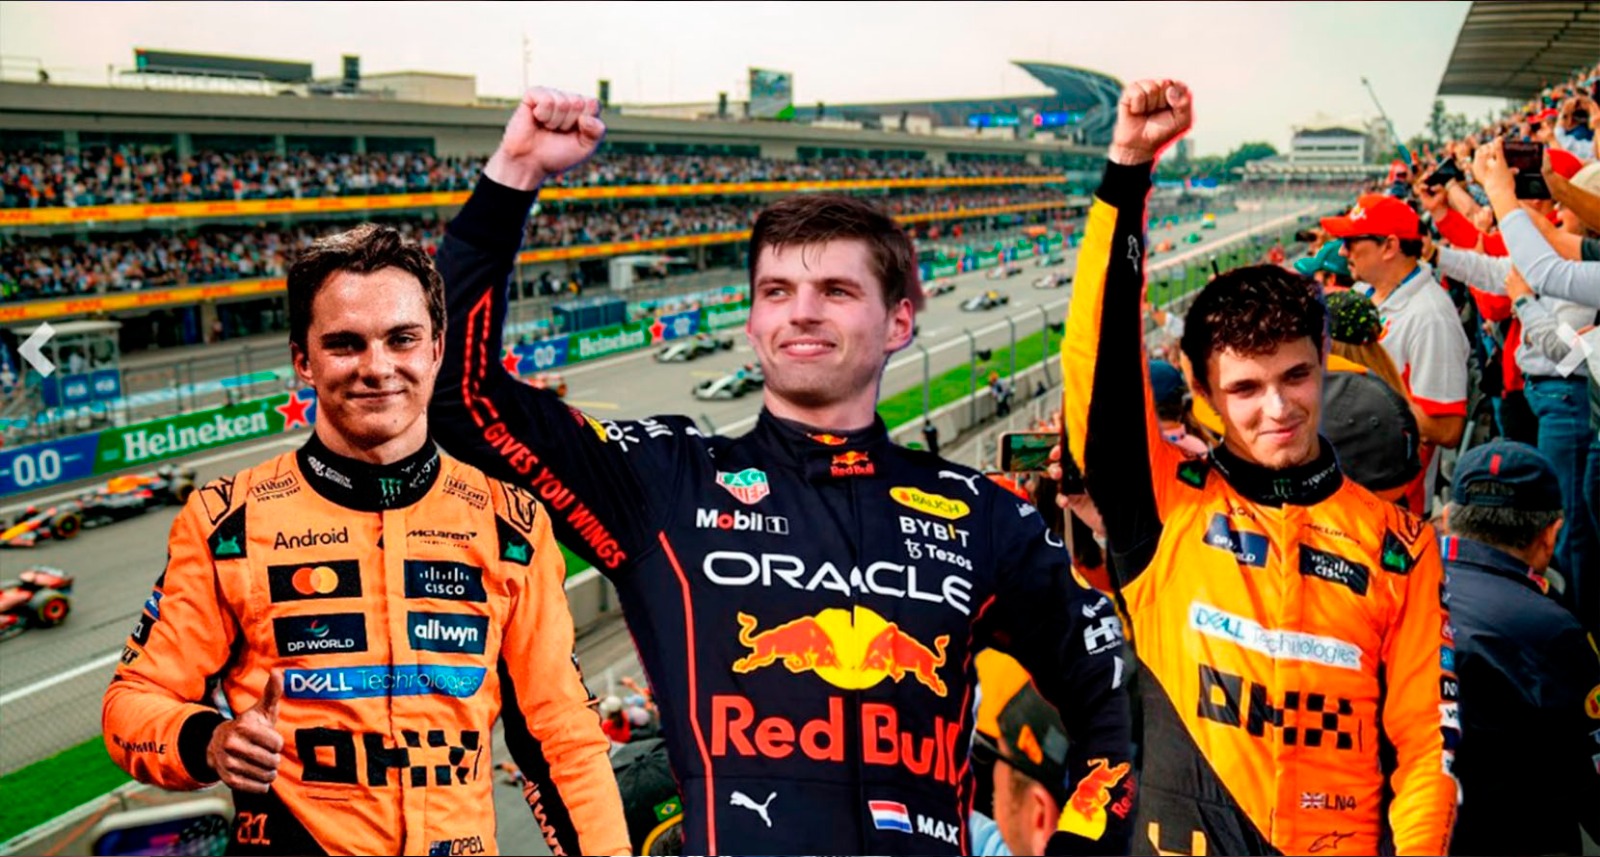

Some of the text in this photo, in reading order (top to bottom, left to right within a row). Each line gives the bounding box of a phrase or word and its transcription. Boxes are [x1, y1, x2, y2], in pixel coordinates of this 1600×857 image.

[13, 411, 269, 487] 0.0 Heineken
[254, 476, 294, 495] Hilton
[483, 420, 628, 571] GIVES YOU WINGS
[911, 493, 961, 514] RAUCH
[696, 508, 763, 532] Mobil
[899, 516, 970, 548] BYBIT
[274, 527, 349, 550] Android
[407, 529, 472, 542] McLaren
[925, 543, 973, 571] Tezos
[425, 583, 465, 595] CISCO
[703, 551, 973, 615] ORACLE
[287, 638, 354, 652] DP WORLD
[414, 619, 478, 647] allwyn
[290, 670, 479, 696] DELL Technologies
[711, 695, 960, 785] Red Bull
[1324, 794, 1358, 811] LN4
[237, 811, 271, 845] 81
[917, 814, 959, 846] MAX
